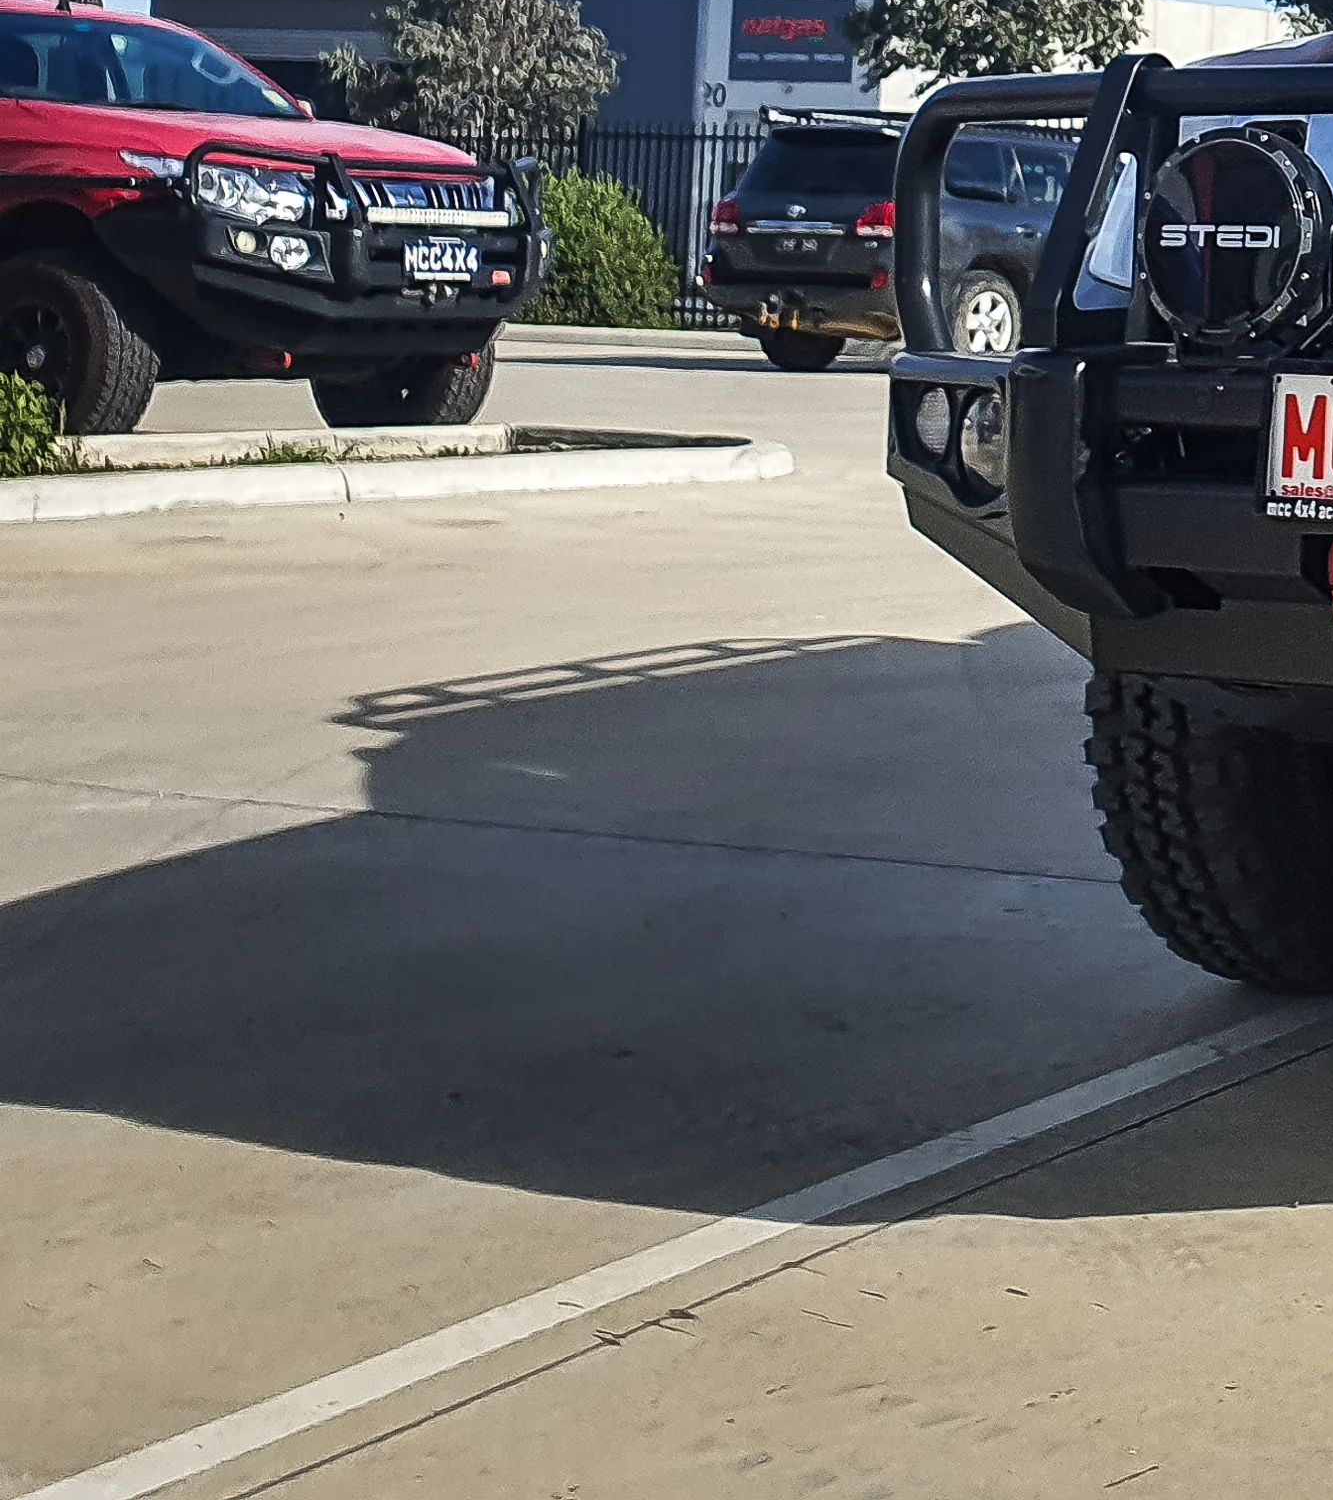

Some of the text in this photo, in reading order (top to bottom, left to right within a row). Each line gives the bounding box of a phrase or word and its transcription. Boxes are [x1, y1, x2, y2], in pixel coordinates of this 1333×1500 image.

[1160, 225, 1280, 250] STEDI
[404, 243, 479, 273] MCC4X4
[1266, 501, 1291, 517] mcc
[1293, 500, 1316, 519] 4x4
